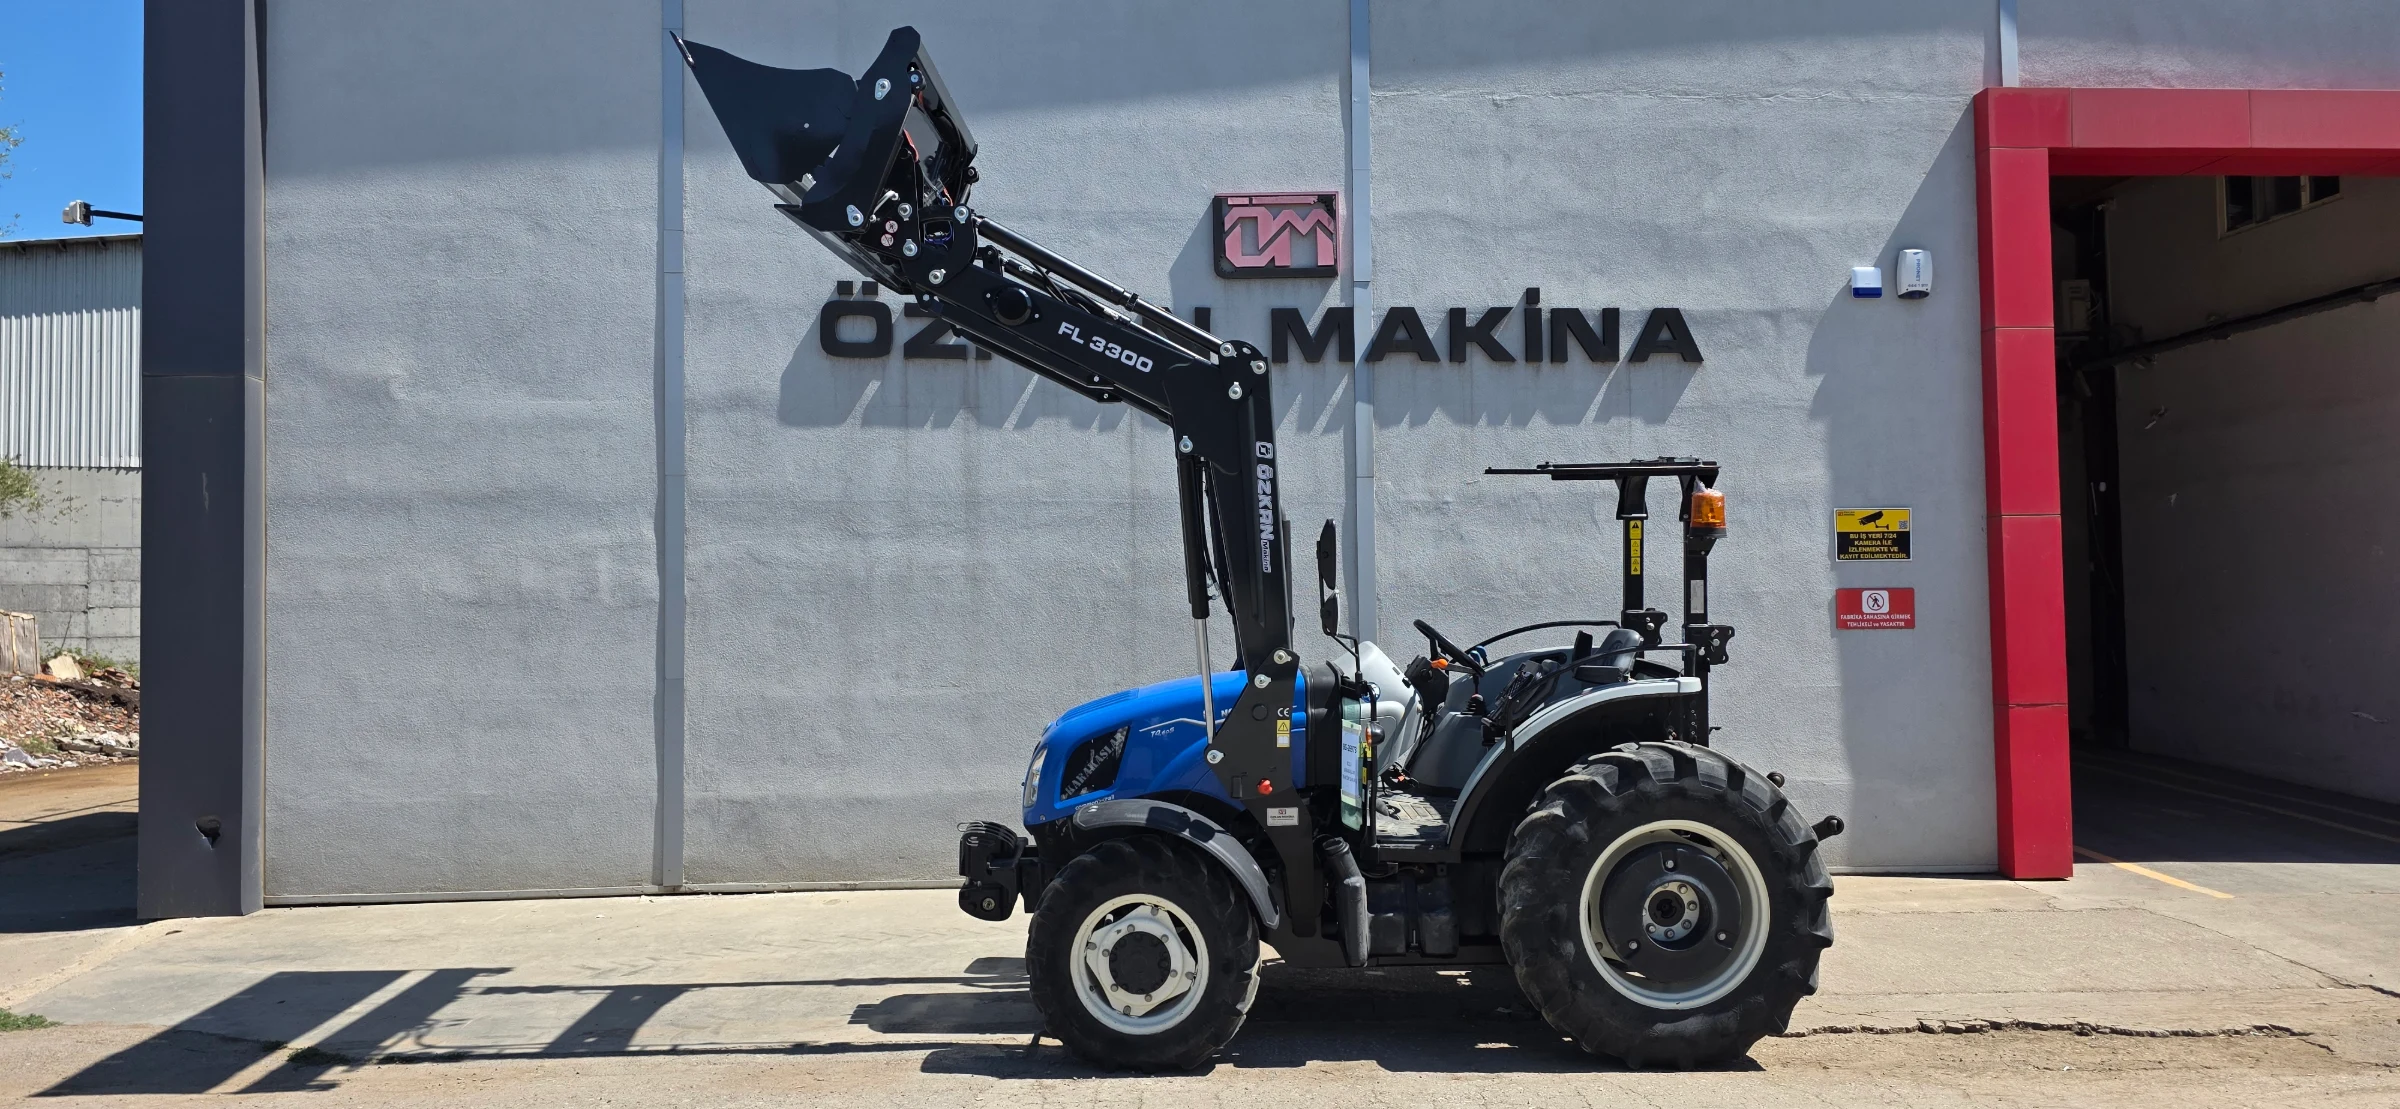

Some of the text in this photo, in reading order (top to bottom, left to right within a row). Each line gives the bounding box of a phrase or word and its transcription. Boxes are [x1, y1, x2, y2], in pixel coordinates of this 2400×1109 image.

[1058, 321, 1154, 373] FL 3300
[1271, 287, 1704, 363] MAKİNA
[1277, 707, 1290, 718] CE
